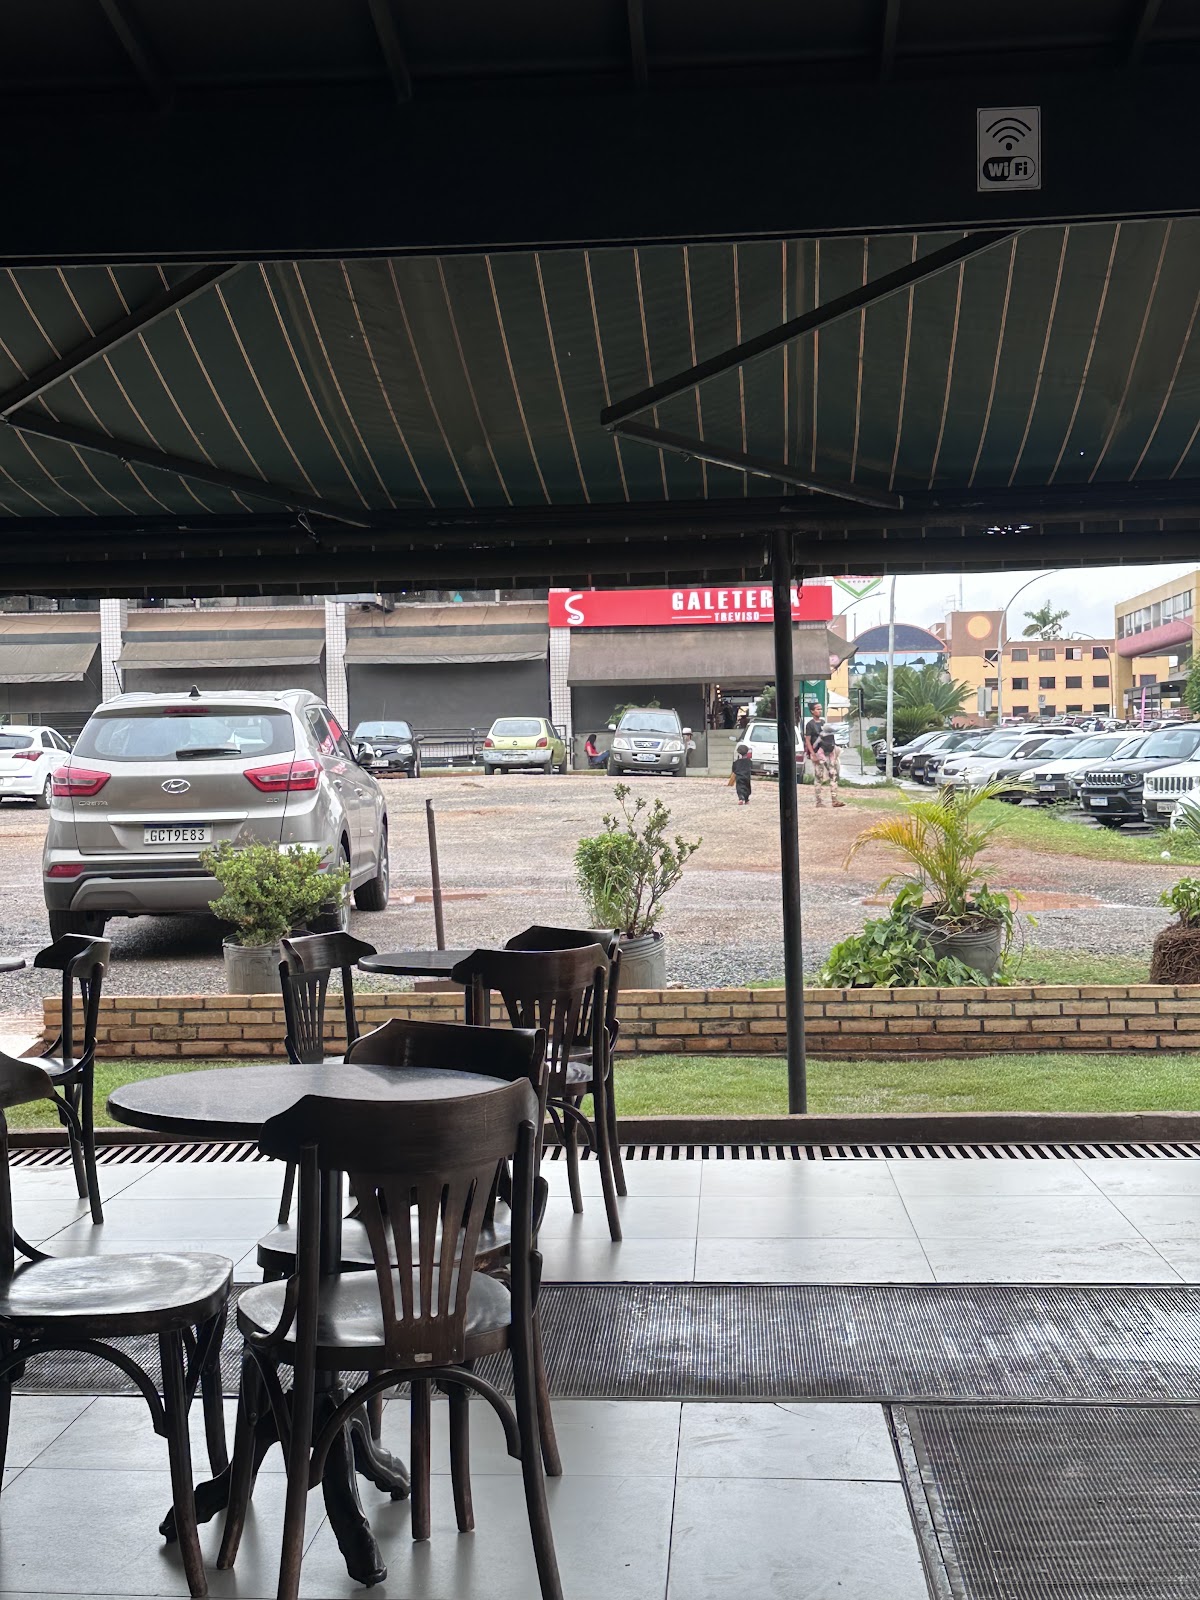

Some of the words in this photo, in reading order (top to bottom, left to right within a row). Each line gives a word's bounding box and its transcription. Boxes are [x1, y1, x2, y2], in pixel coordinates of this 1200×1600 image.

[671, 589, 800, 611] GALETERA
[714, 611, 760, 622] TREVISO
[150, 829, 205, 842] GCT9E83
